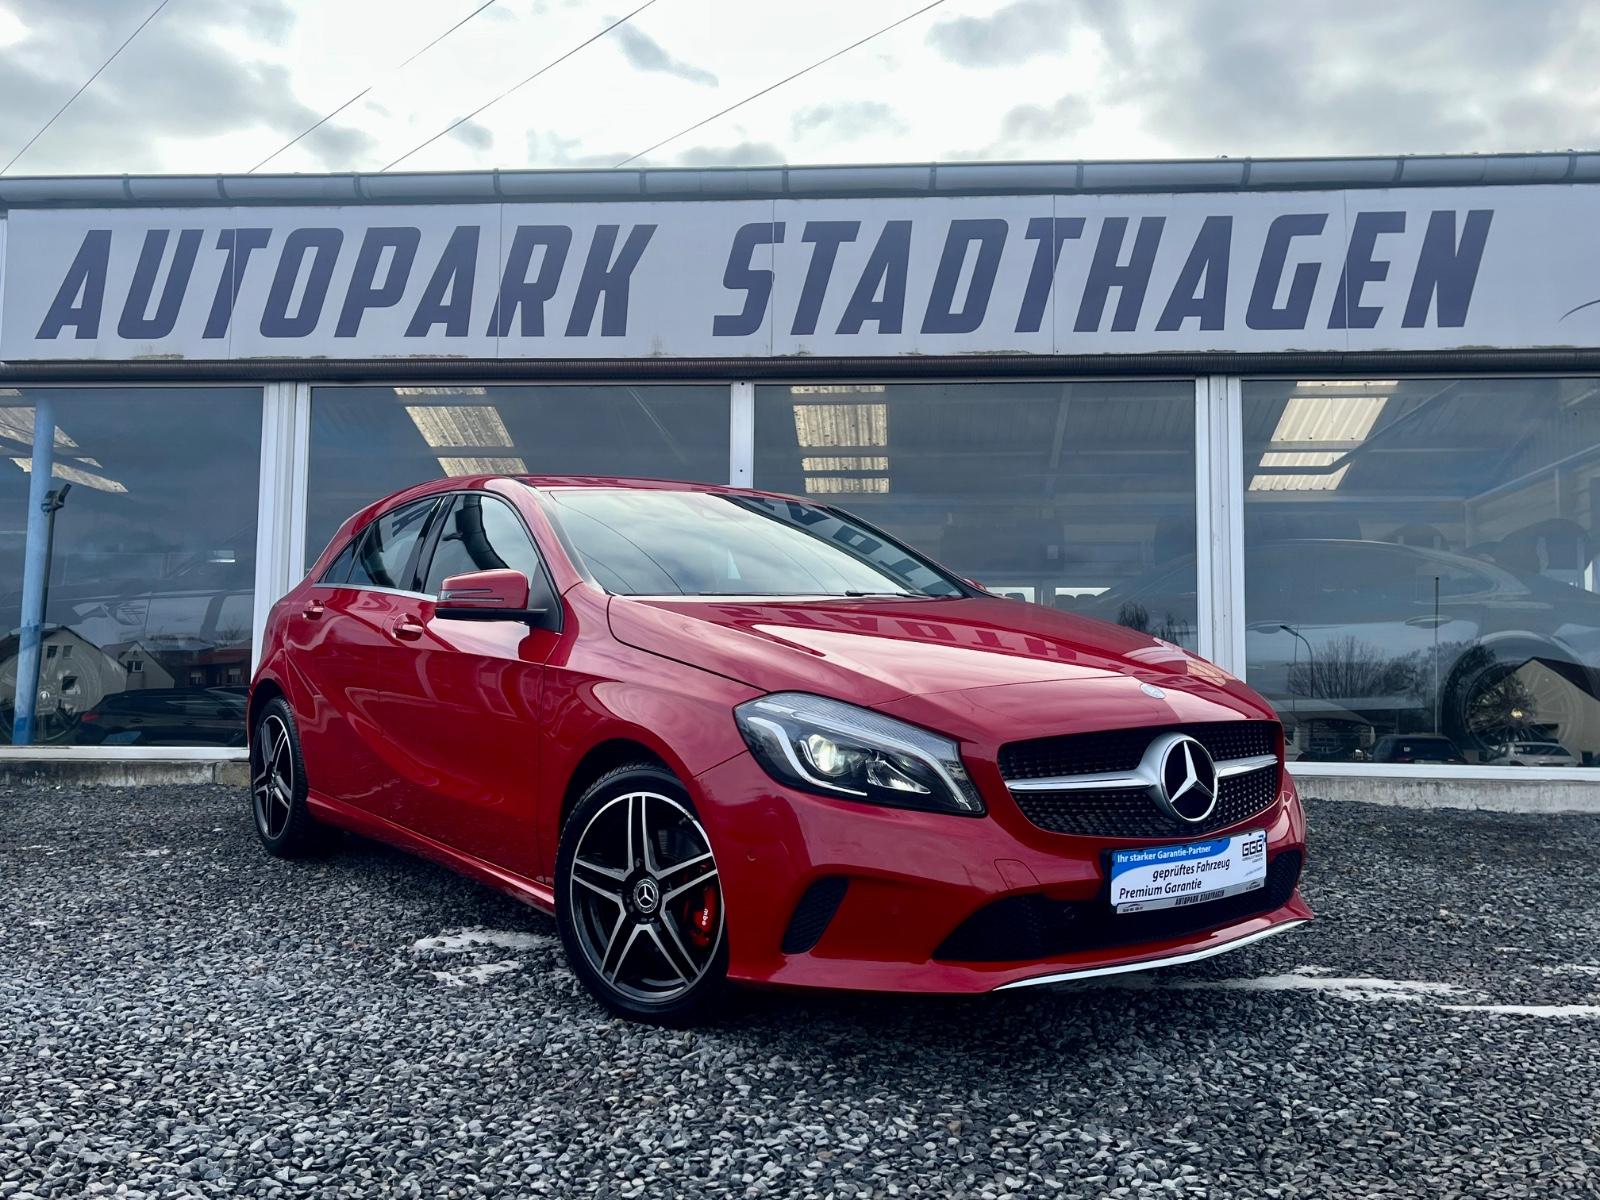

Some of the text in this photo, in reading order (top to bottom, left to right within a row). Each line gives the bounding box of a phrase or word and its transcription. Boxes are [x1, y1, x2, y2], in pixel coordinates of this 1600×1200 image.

[35, 209, 1494, 340] AUTOPARK STADTHAGEN
[1117, 845, 1212, 863] Ihr starker Garantie-Partner
[1242, 839, 1263, 857] GGG
[1152, 864, 1195, 882] geprüftes
[1196, 858, 1231, 874] Fahrzeug
[1119, 878, 1202, 899] Premium Garantie
